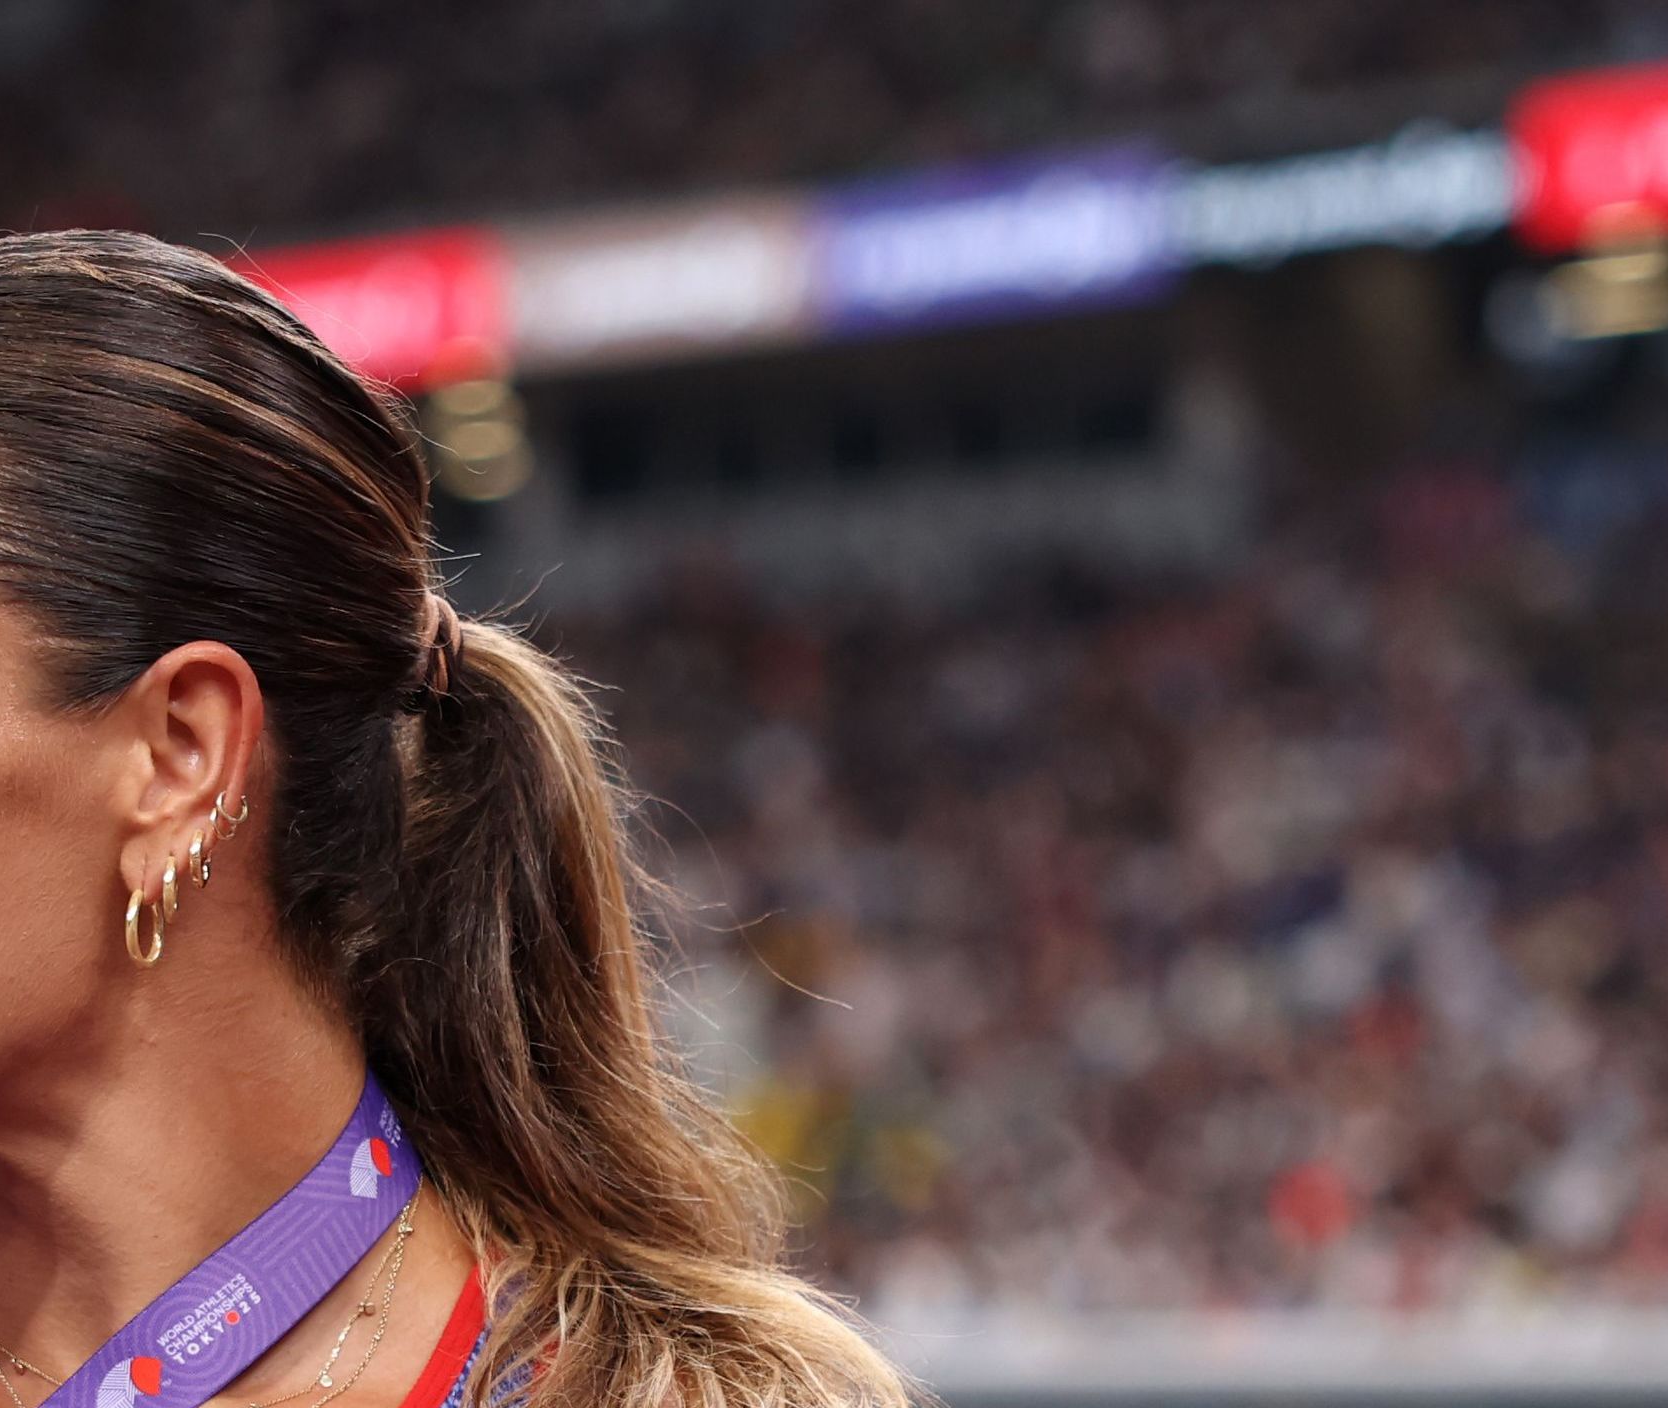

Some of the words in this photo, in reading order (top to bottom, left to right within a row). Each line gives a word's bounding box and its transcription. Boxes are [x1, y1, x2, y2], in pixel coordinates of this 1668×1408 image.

[156, 1315, 195, 1347] WORLD
[194, 1273, 246, 1319] ATHLETICS
[165, 1282, 253, 1355] CHAMPIONSHIPS
